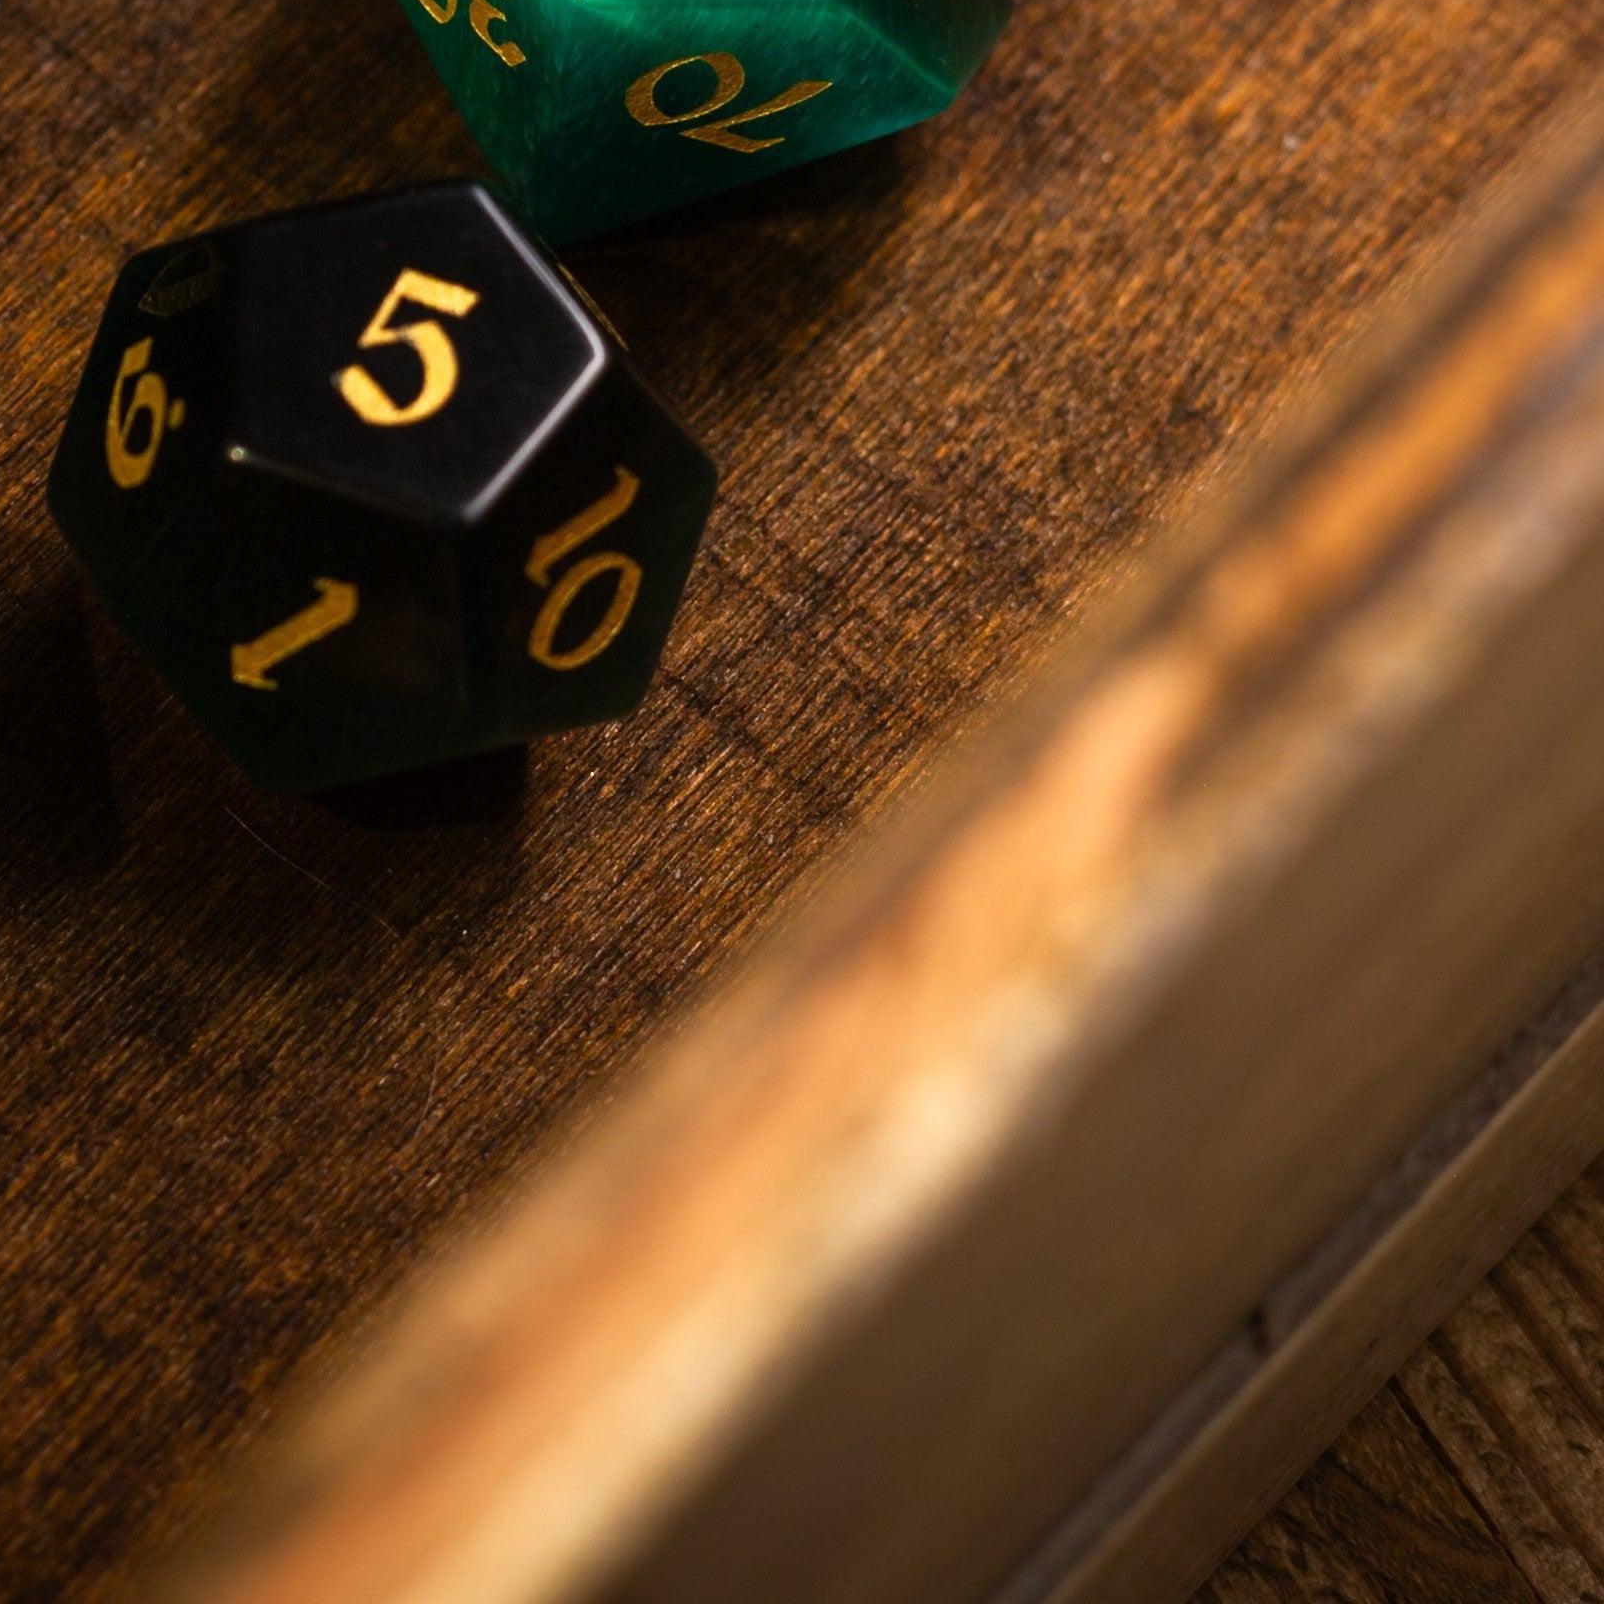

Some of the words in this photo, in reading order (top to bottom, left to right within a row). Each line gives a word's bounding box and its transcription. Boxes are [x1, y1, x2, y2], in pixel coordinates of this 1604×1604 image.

[624, 51, 832, 153] 70
[336, 268, 481, 428] 5
[230, 577, 359, 692] 1
[524, 463, 644, 672] 10
